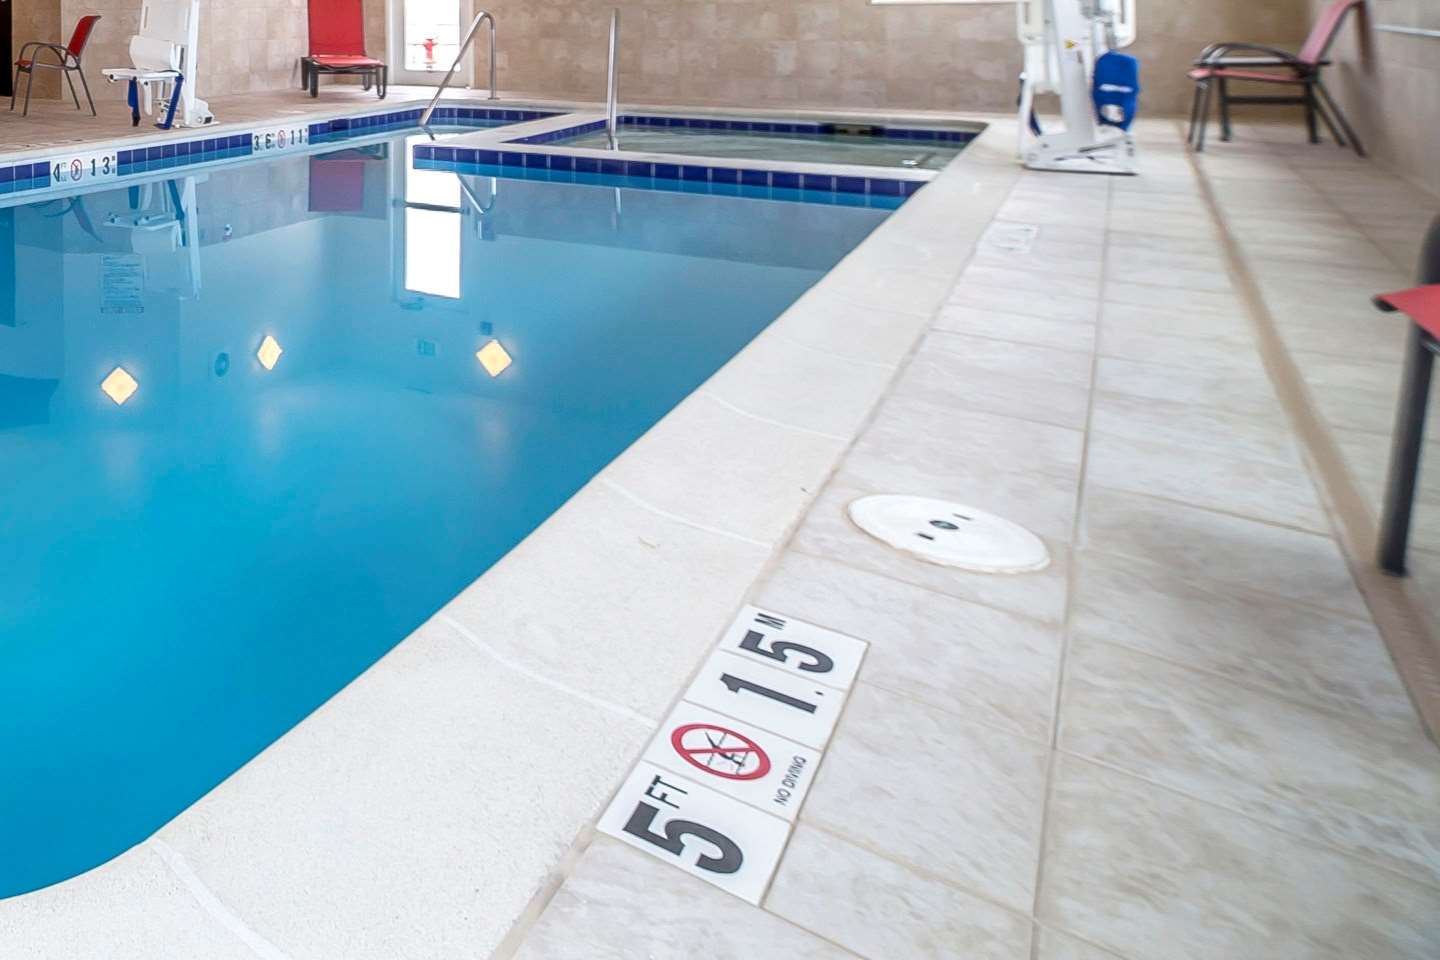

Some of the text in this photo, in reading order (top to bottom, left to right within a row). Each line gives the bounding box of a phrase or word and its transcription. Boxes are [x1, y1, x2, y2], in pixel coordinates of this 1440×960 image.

[754, 612, 787, 631] M
[773, 755, 807, 807] NO DIVING
[622, 774, 744, 874] 5 FT
